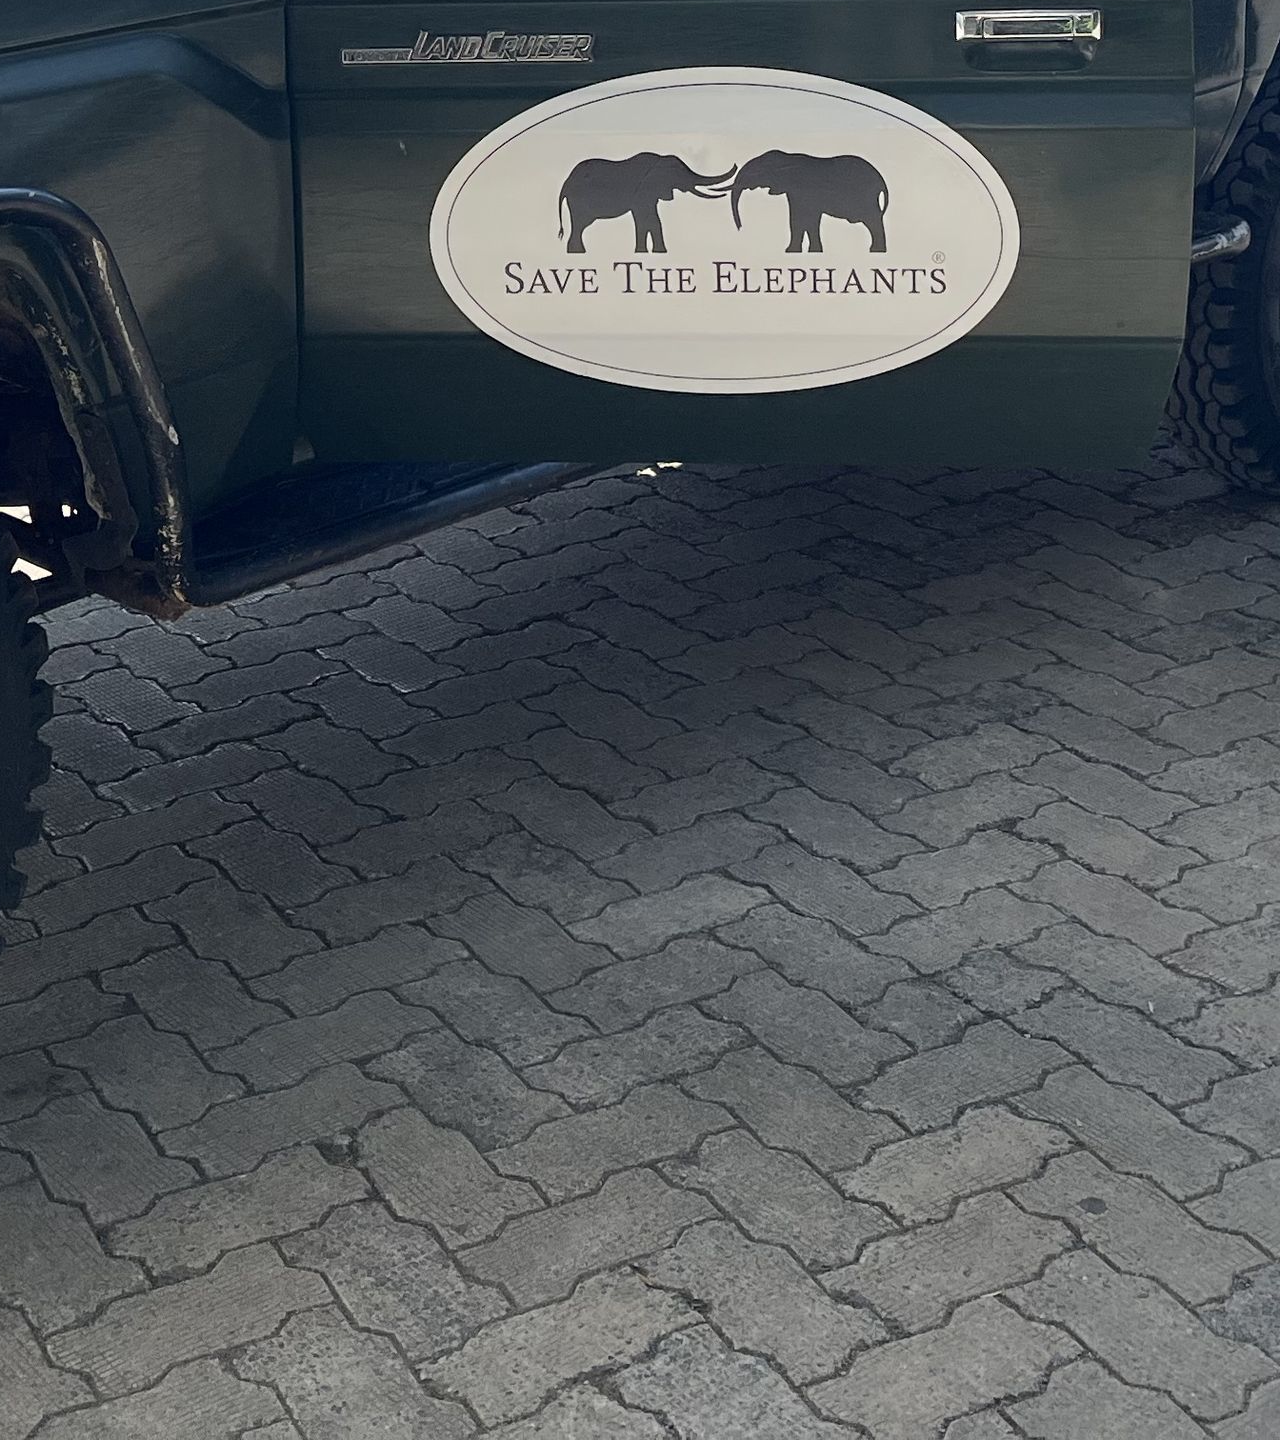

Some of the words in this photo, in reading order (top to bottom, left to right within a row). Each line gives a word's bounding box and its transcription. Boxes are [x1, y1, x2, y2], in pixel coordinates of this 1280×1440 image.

[504, 261, 600, 295] SAVE
[612, 261, 698, 294] THE
[712, 261, 948, 295] ELEPHANTS
